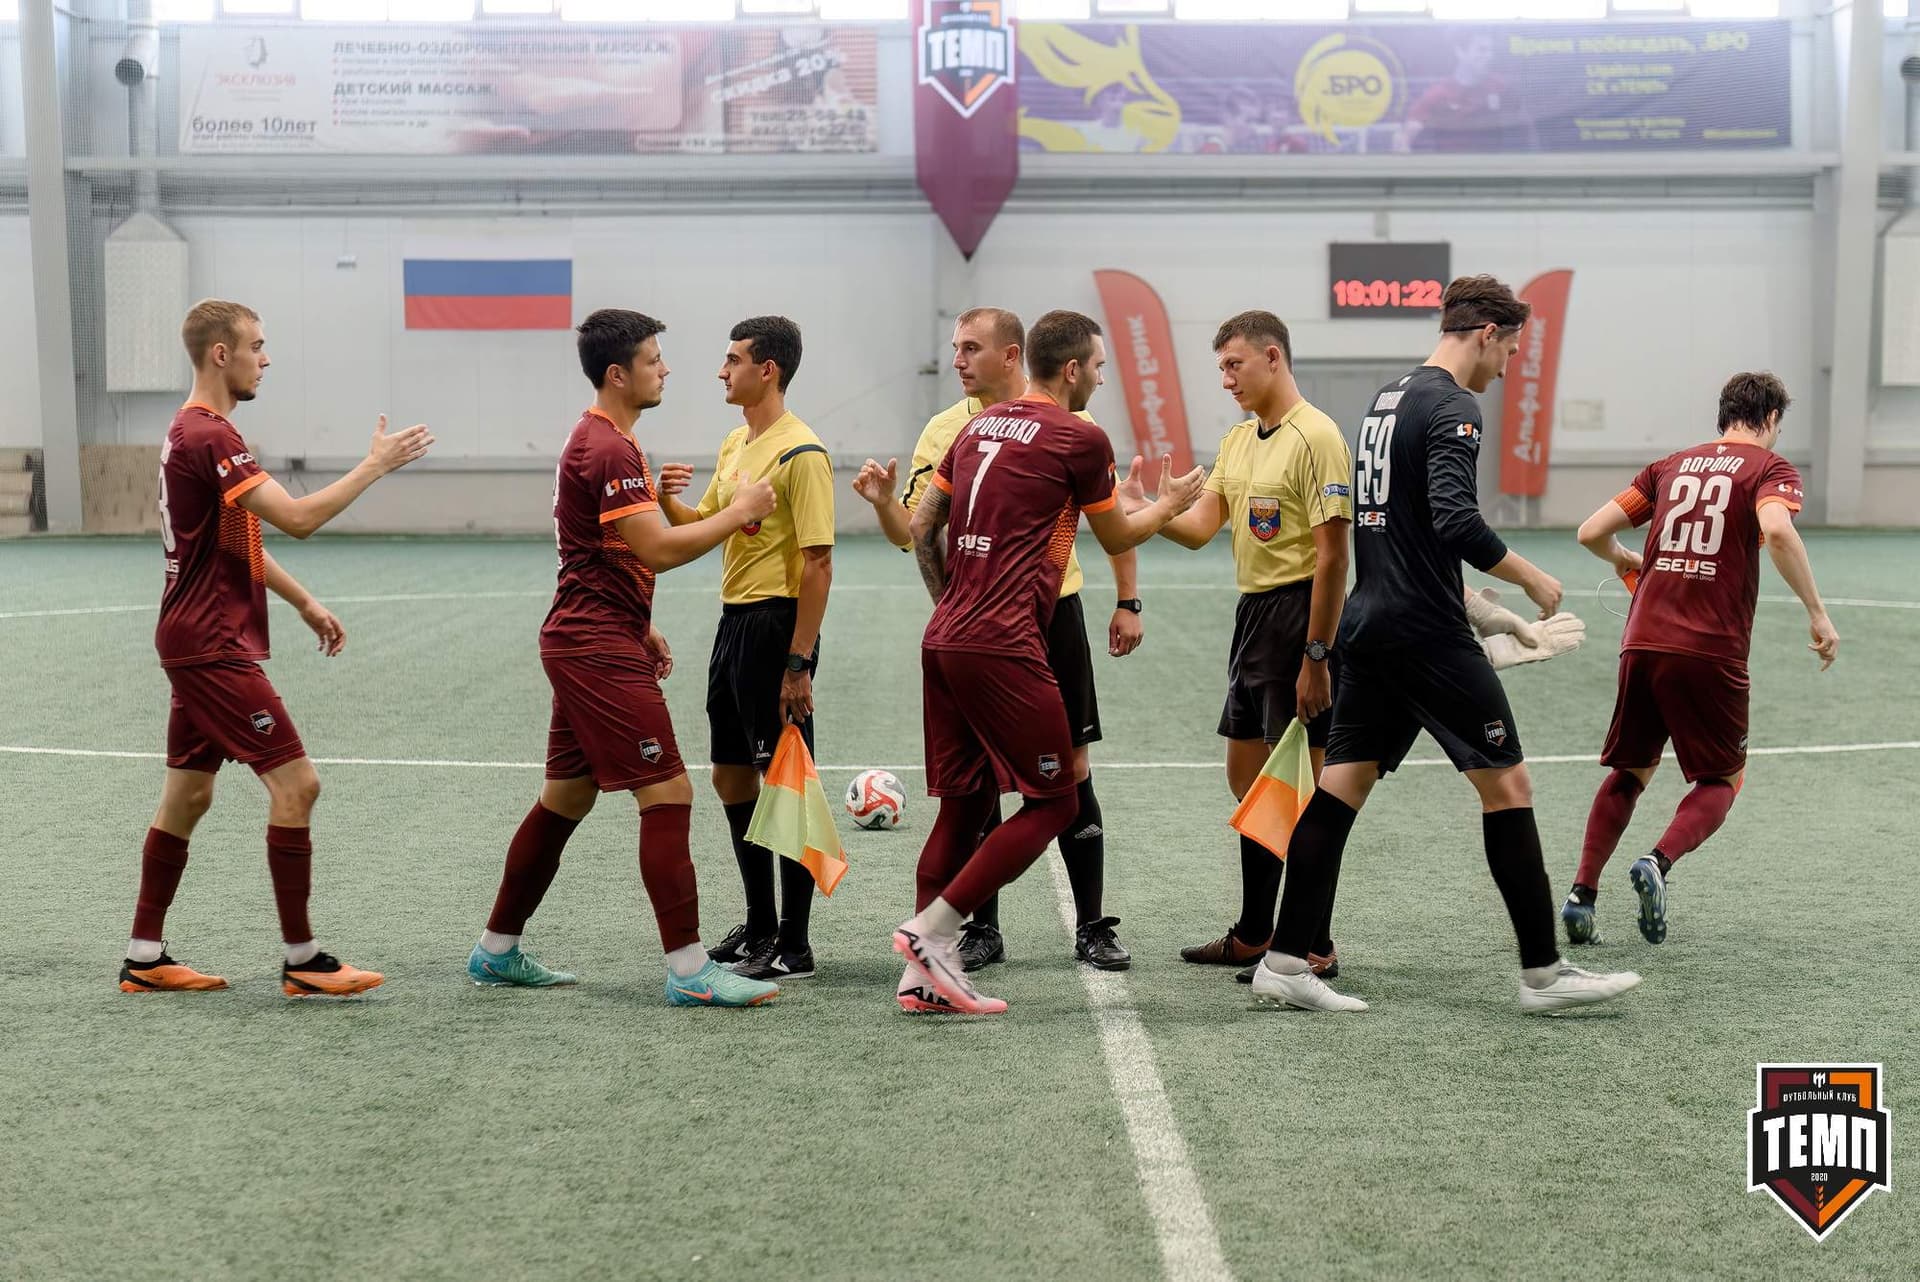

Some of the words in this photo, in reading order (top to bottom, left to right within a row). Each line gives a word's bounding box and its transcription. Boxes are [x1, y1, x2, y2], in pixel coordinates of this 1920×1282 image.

[928, 29, 1004, 70] ТЕМП
[334, 81, 411, 96] ДЕТСКИЙ
[192, 116, 253, 133] более
[262, 117, 317, 133] 10лет
[1357, 414, 1396, 505] 59
[1679, 456, 1745, 474] ВОРОНА
[967, 440, 1003, 528] 7
[1659, 474, 1733, 555] 23
[1655, 557, 1717, 576] SEUS
